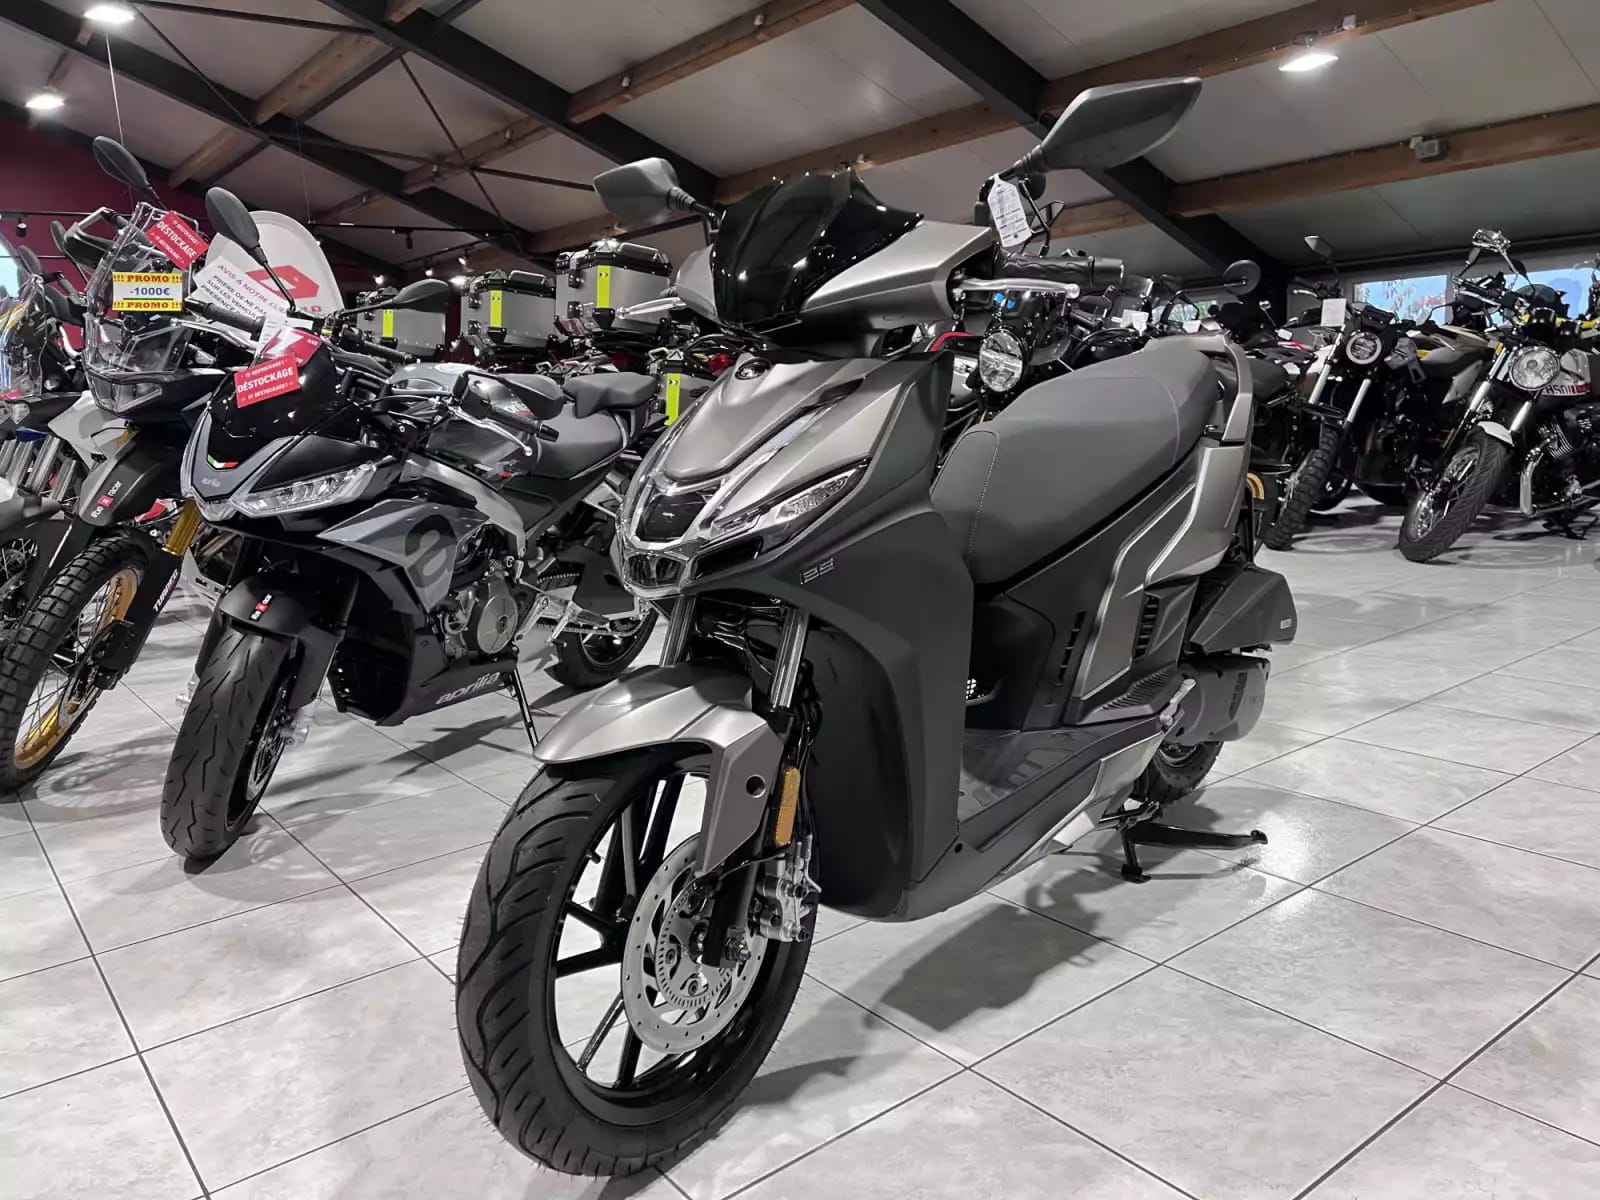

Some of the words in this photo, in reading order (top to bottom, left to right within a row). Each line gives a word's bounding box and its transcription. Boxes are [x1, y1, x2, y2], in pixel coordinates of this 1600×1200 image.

[157, 220, 196, 258] DÉSTOCKAGE
[130, 287, 170, 296] -1000€
[207, 280, 220, 290] SUR
[220, 290, 231, 299] LES
[218, 264, 235, 279] AVIS
[243, 283, 266, 302] NOTRE
[200, 285, 234, 311] PRESENCE
[245, 299, 254, 307] NE
[237, 366, 294, 393] DÉSTOCKAGE
[800, 558, 834, 584] 125
[436, 672, 500, 704] aprilia
